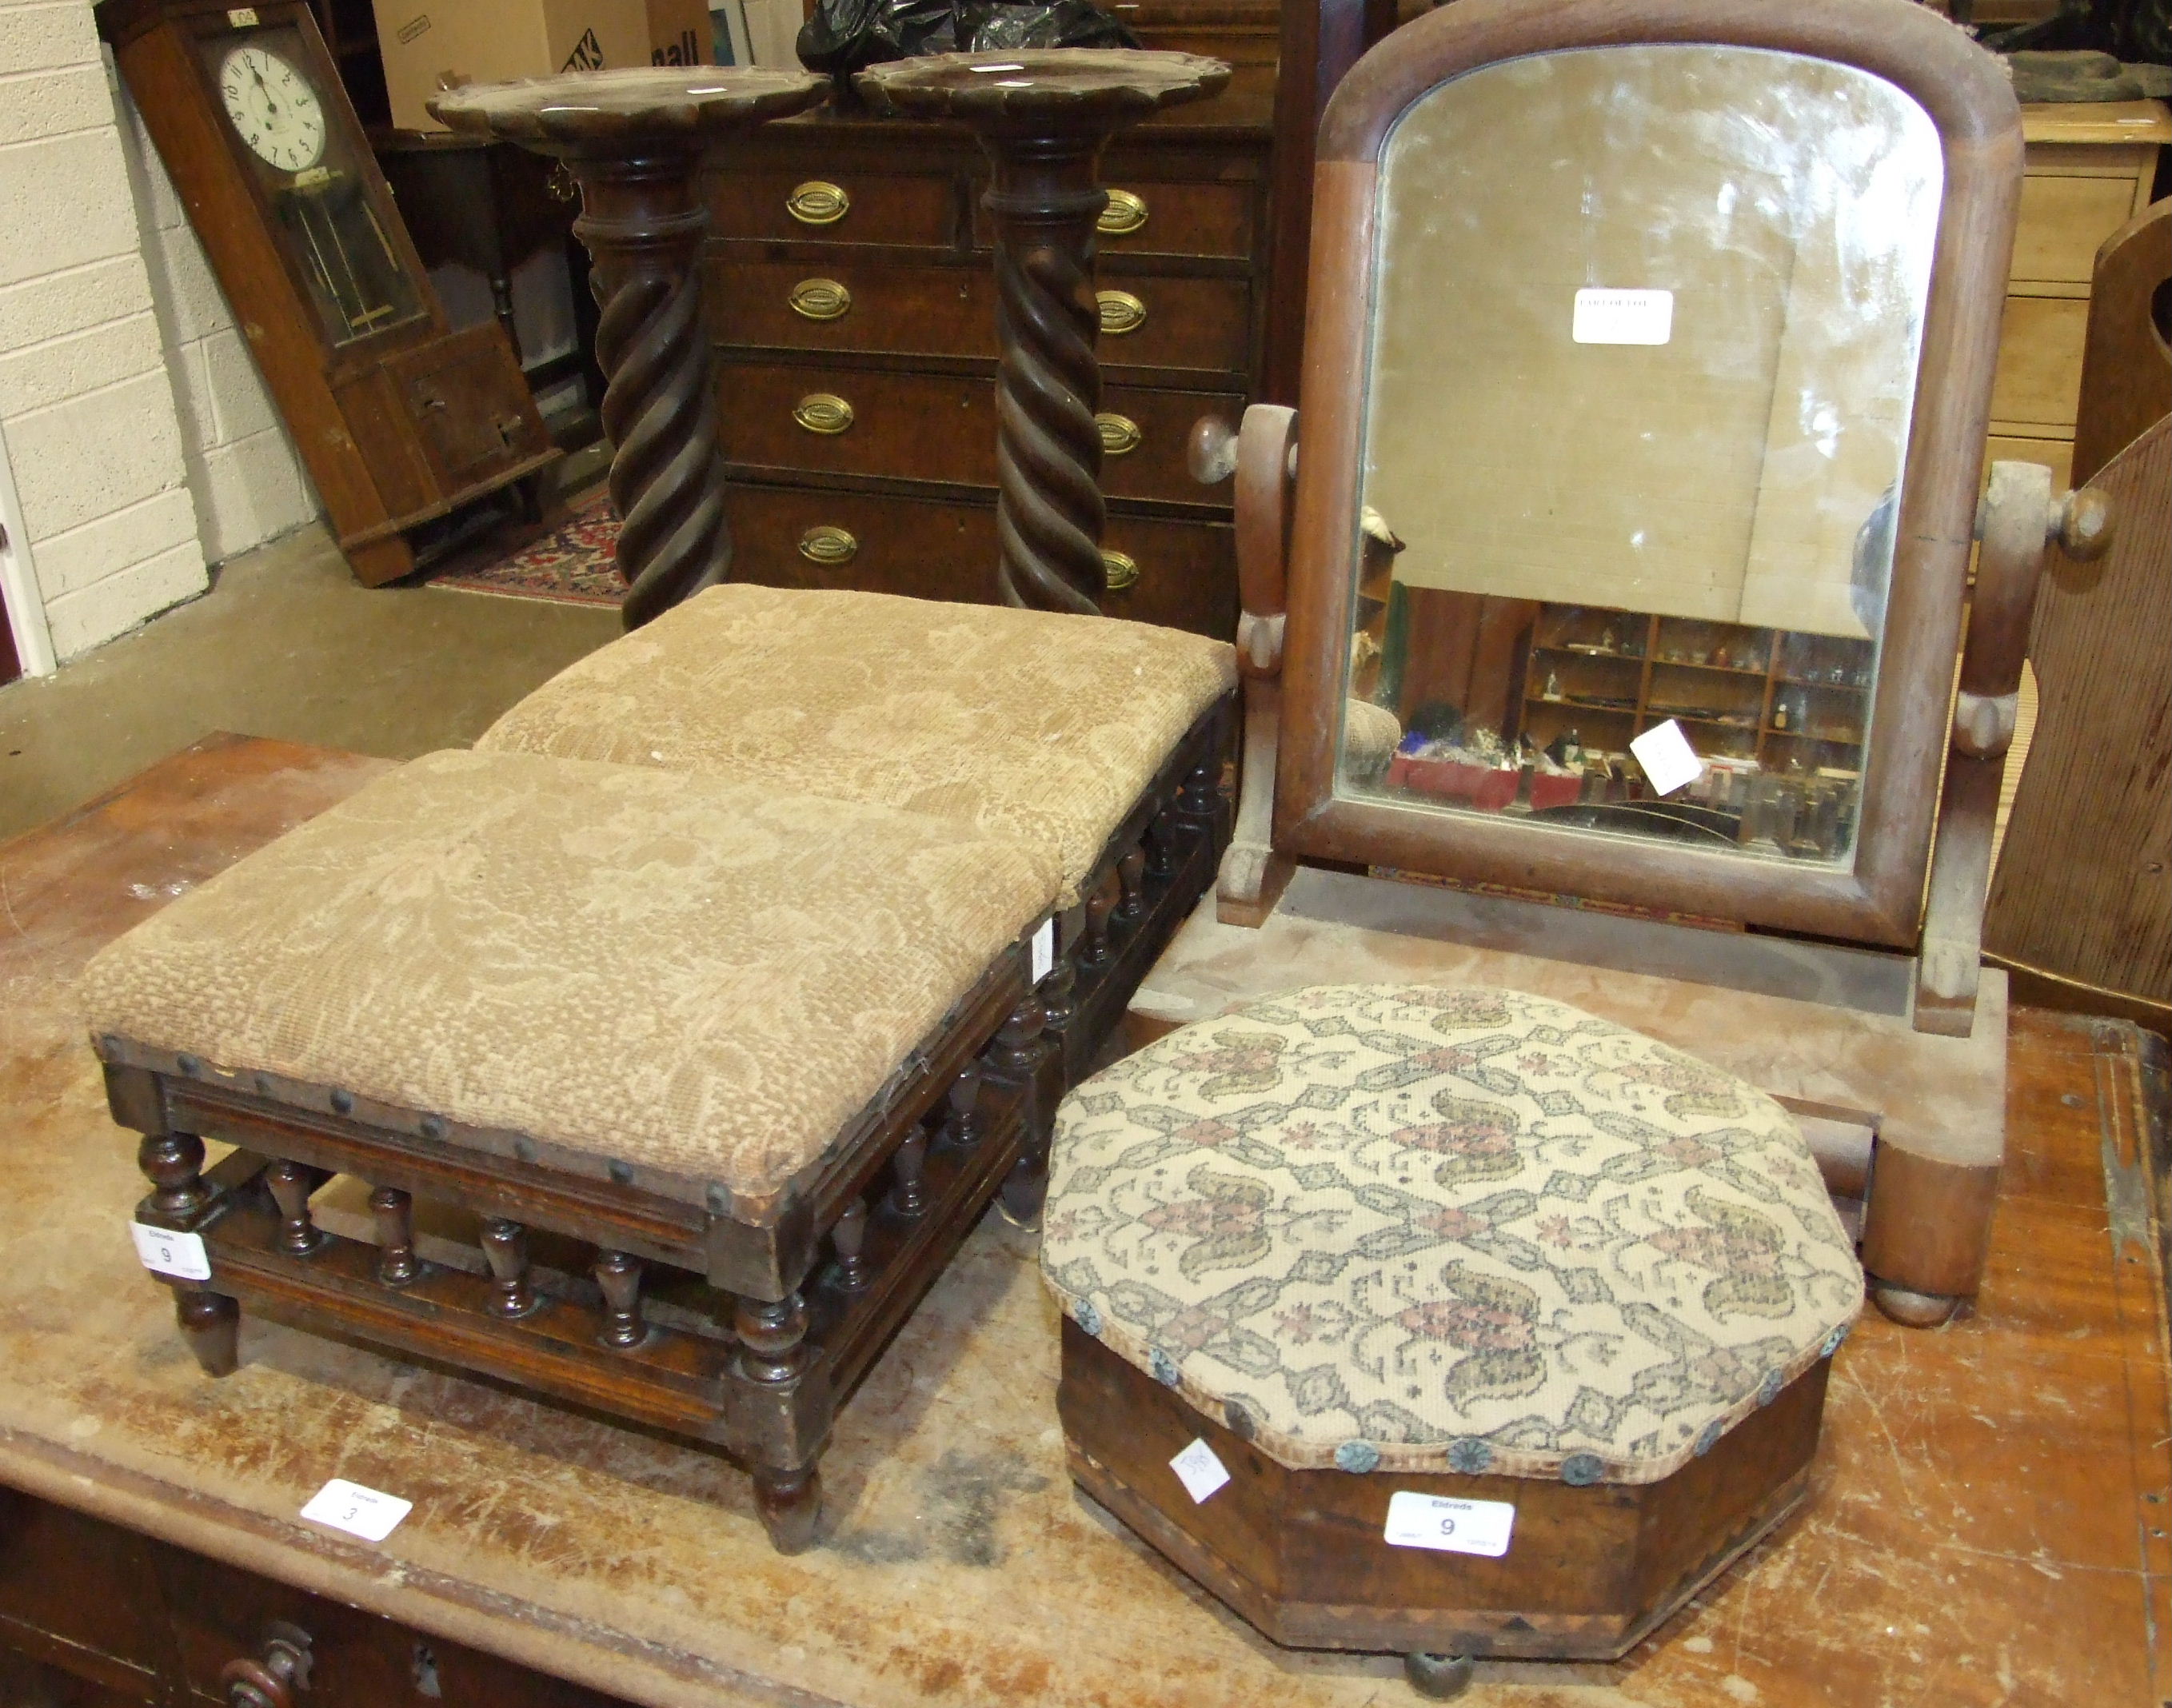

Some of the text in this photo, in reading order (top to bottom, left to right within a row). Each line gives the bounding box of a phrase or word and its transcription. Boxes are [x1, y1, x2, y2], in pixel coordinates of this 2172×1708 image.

[242, 55, 255, 69] 12
[230, 64, 243, 78] 11
[228, 85, 239, 101] 10
[161, 1247, 171, 1263] 9
[342, 1507, 357, 1520] 3
[1441, 1518, 1455, 1536] 9
